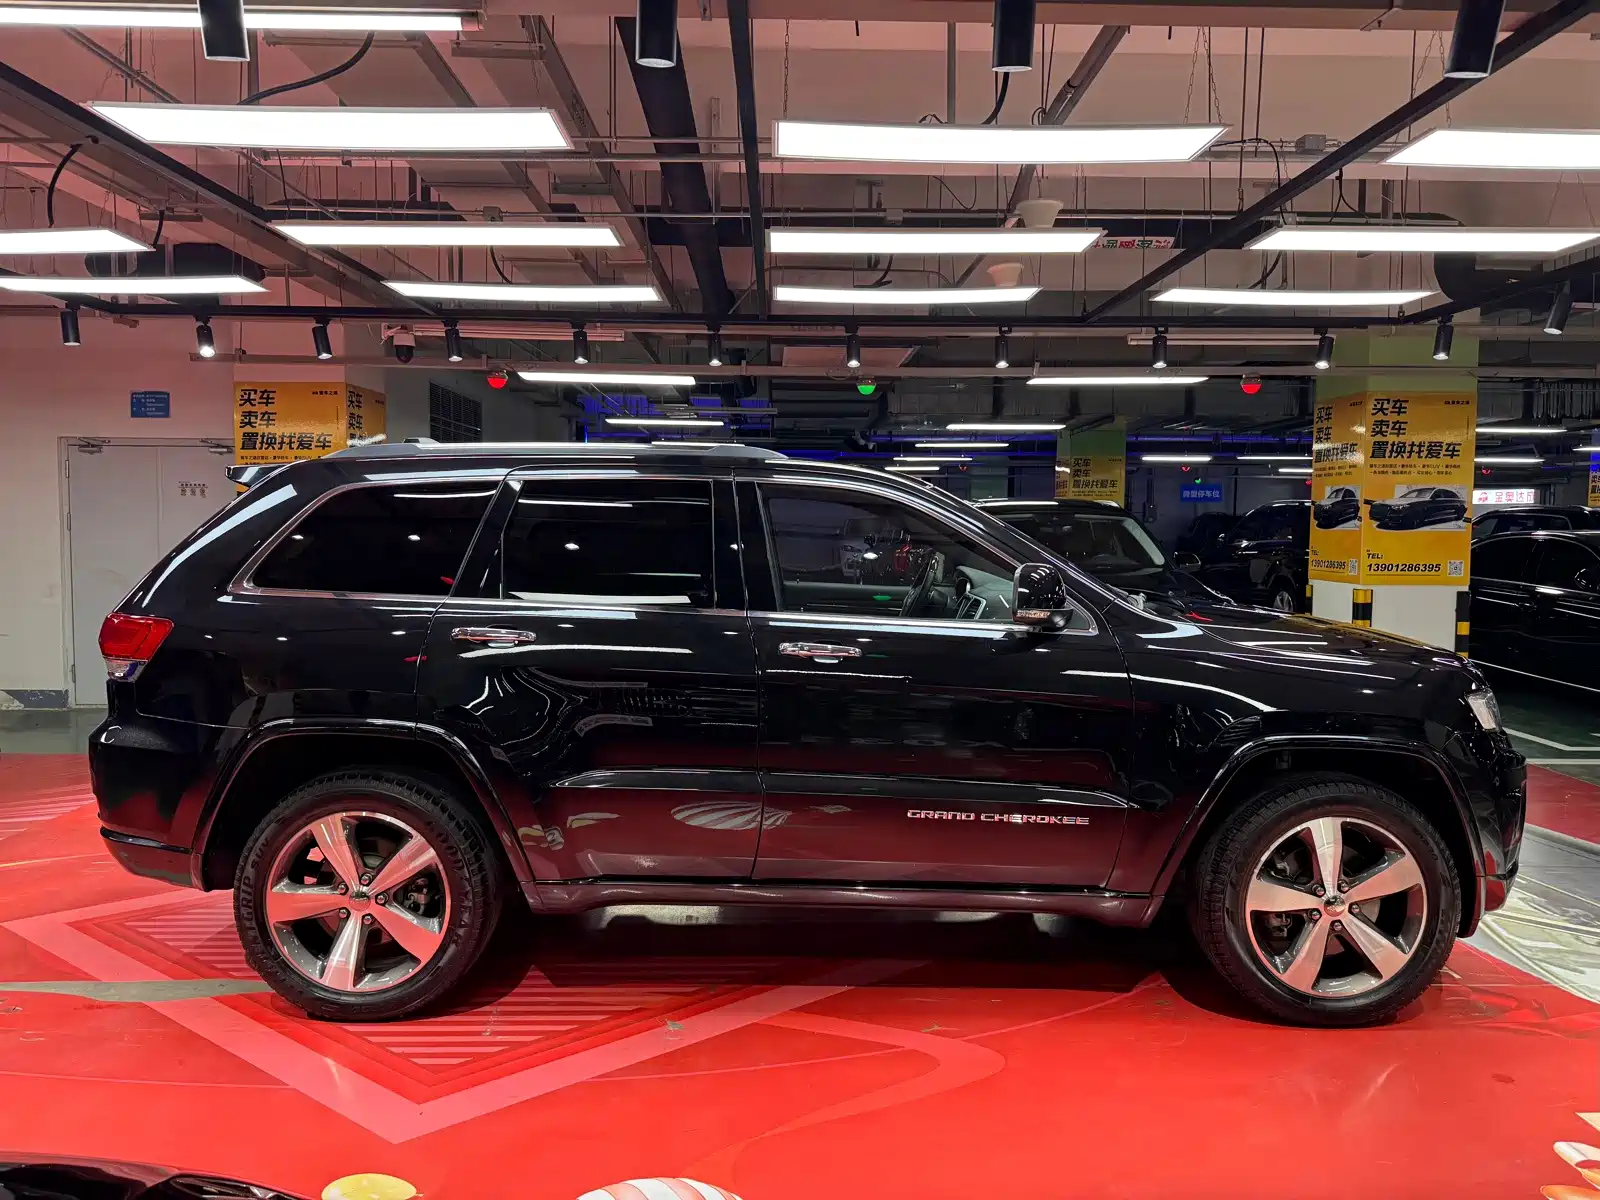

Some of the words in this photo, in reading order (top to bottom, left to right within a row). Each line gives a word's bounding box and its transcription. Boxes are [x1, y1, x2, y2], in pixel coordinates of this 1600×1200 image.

[239, 389, 277, 407] 买车
[347, 390, 363, 410] 买车
[1371, 398, 1410, 416] 买车
[239, 410, 277, 429] 卖车
[1315, 406, 1333, 424] 买车
[1370, 419, 1409, 438] 卖车
[240, 432, 333, 451] 置换找爱车
[1370, 440, 1462, 459] 置换找爱车
[1311, 560, 1346, 570] 13901286395
[1366, 563, 1441, 572] 13901286395
[907, 809, 976, 821] GRAND
[980, 813, 1090, 825] CHEROKEE
